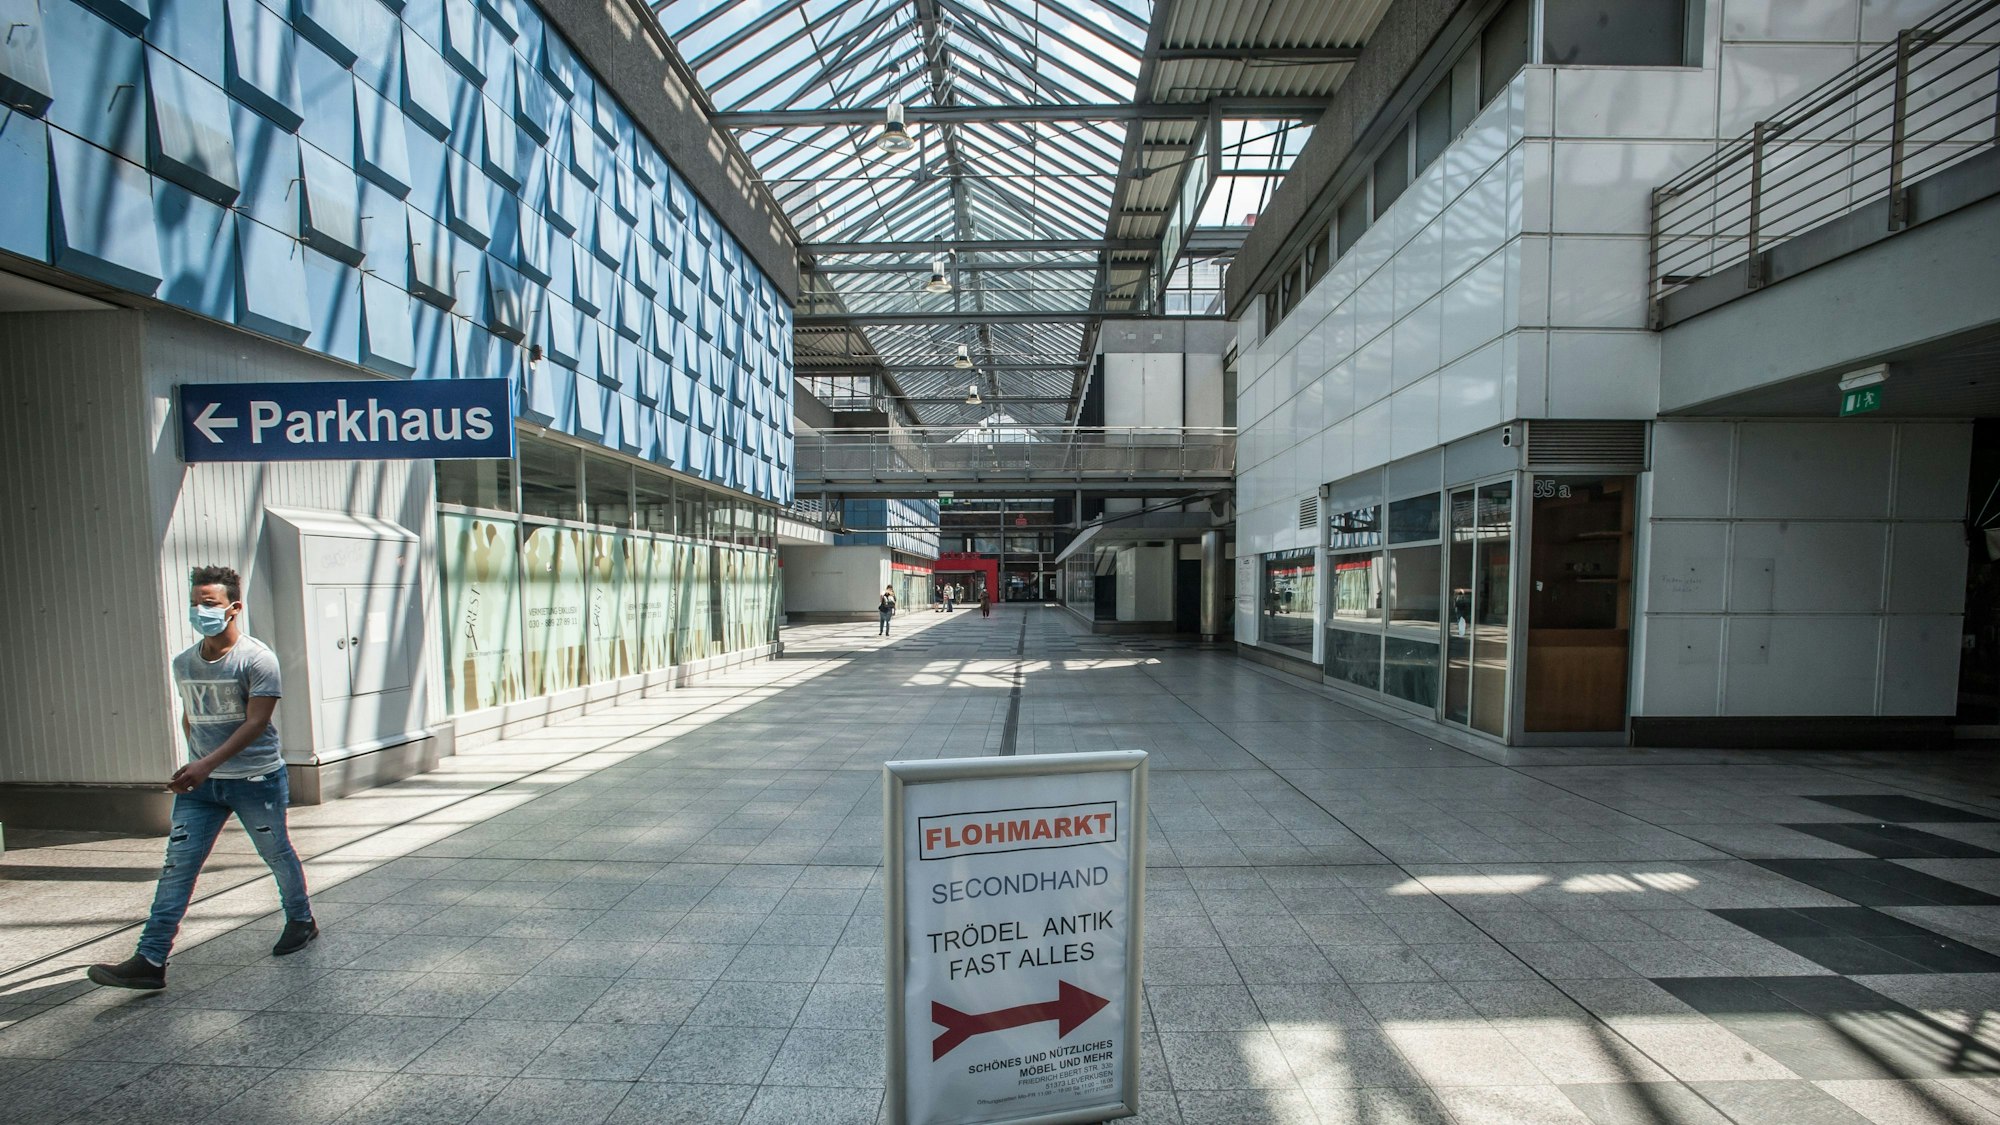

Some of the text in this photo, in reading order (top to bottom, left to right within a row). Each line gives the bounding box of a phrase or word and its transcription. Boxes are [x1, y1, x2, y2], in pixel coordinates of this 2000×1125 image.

[250, 398, 494, 444] Parkhaus
[1534, 479, 1571, 499] 35 a
[925, 813, 1112, 851] FLOHMARKT
[931, 866, 1109, 905] SECONDHAND
[927, 910, 1114, 953] TRÖDEL ANTIK
[950, 942, 1095, 980] FAST ALLES
[968, 1039, 1113, 1074] SCHÖNES UND NÜTZLICHES
[1020, 1051, 1113, 1078] MÖBEL UND MEHR
[1018, 1073, 1058, 1086] FRIEDRICH
[1059, 1068, 1082, 1080] EBERT
[1045, 1069, 1114, 1090] 51373 LEVERKUSEN
